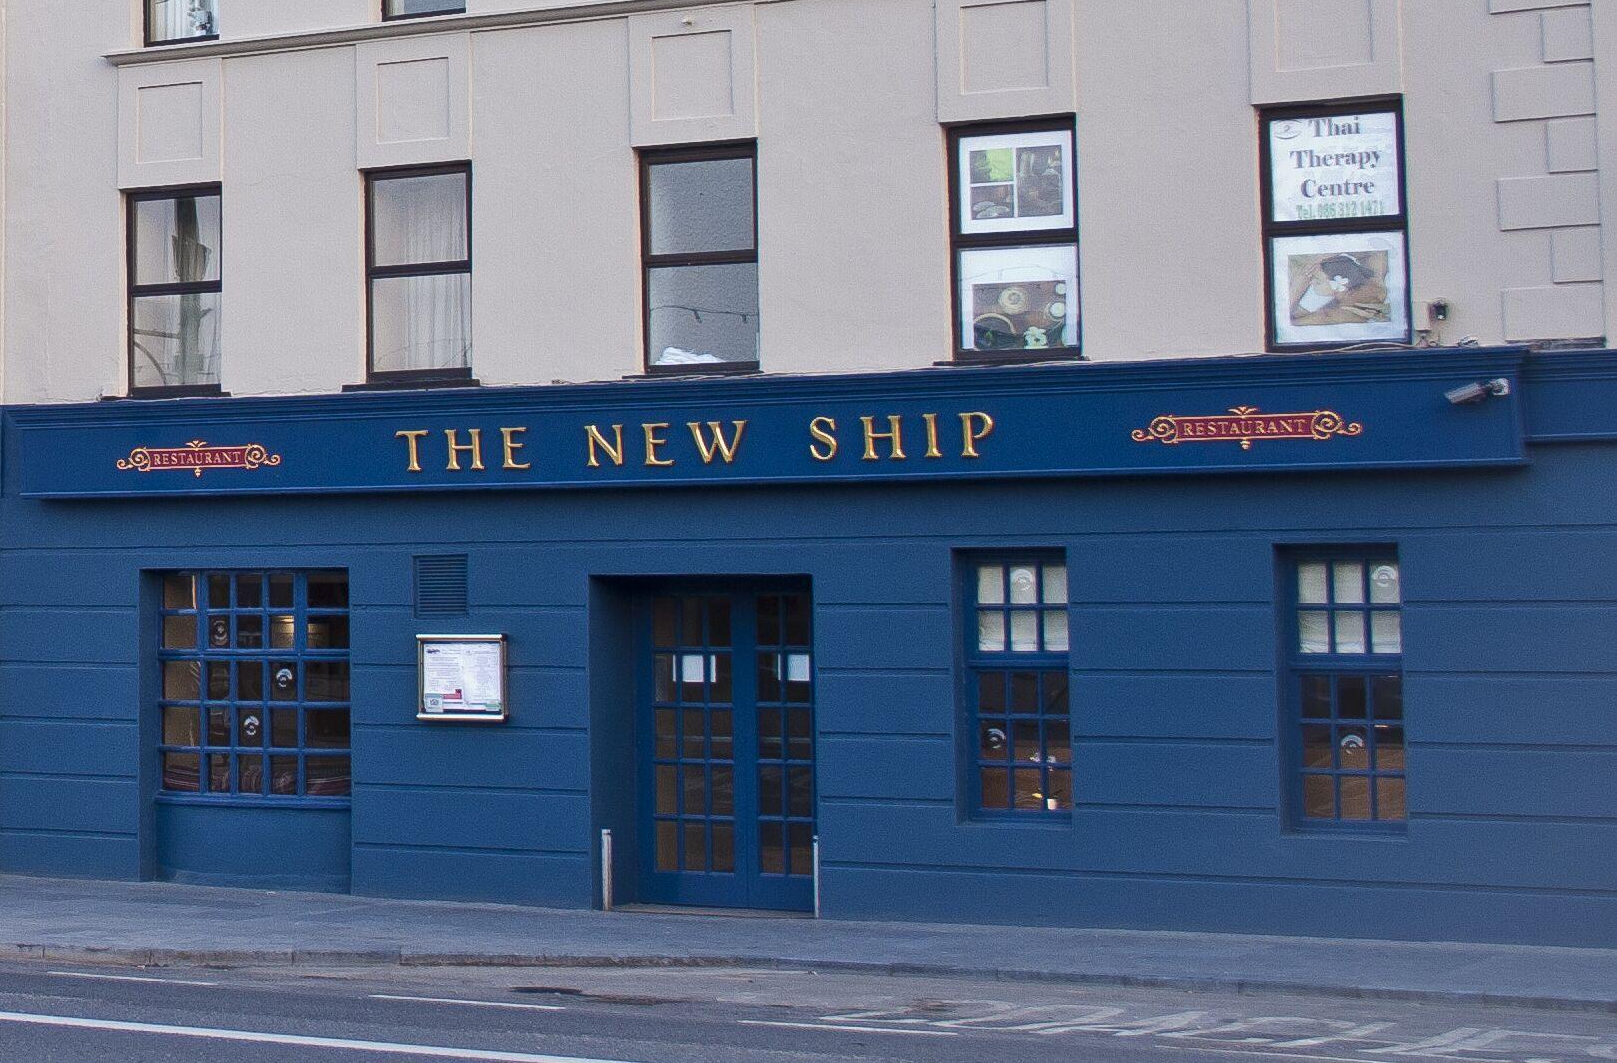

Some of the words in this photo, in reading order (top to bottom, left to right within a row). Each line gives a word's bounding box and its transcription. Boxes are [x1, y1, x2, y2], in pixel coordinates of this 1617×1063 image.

[1308, 116, 1361, 137] Thai
[1289, 149, 1381, 170] Therapy
[1300, 179, 1375, 198] Centre
[1183, 419, 1306, 437] RESTAURANT
[394, 426, 531, 471] THE
[584, 419, 747, 466] NEW
[809, 411, 995, 460] SHIP
[153, 451, 242, 466] RESTAURANT
